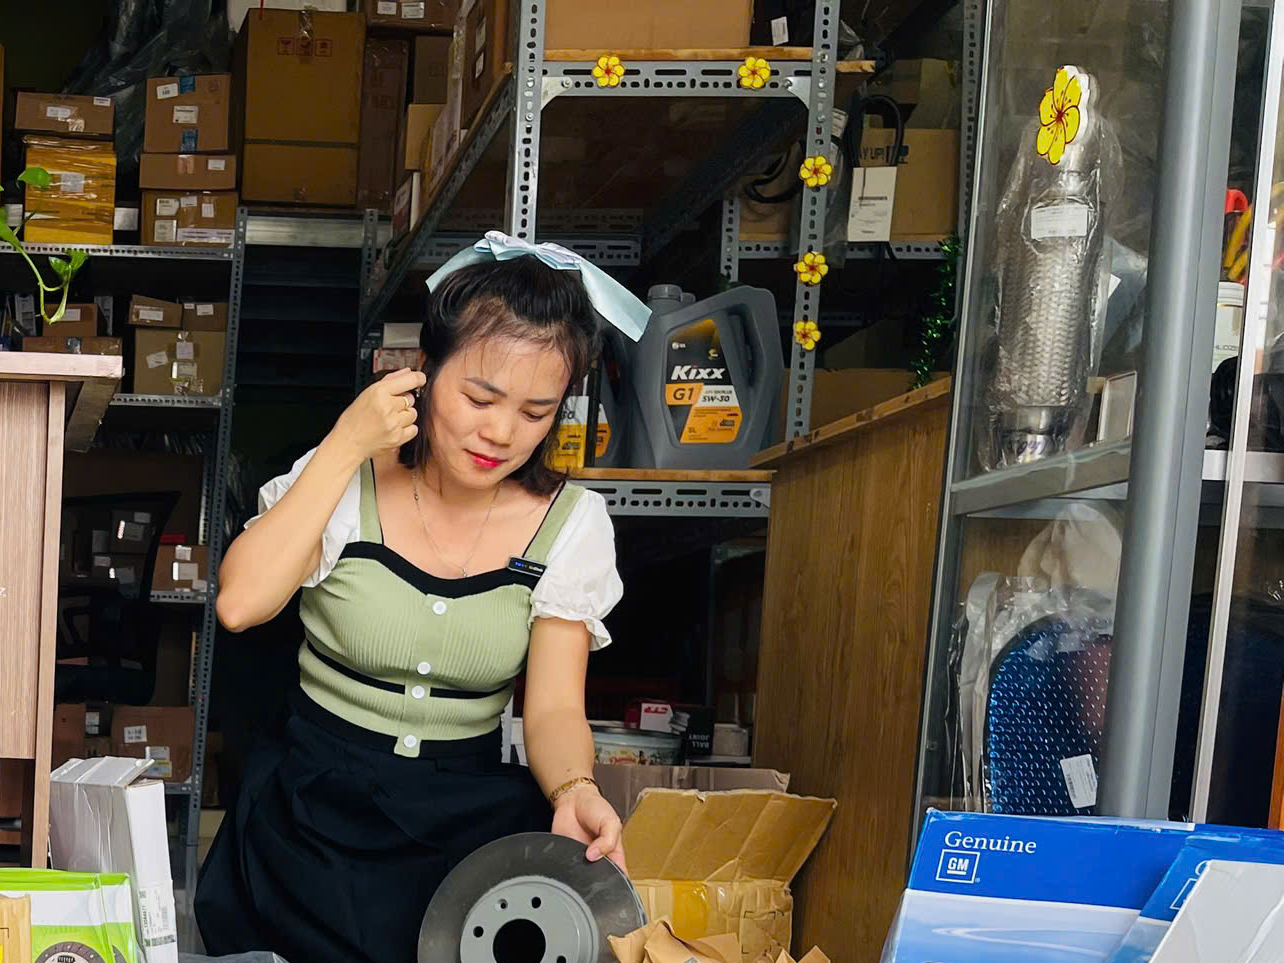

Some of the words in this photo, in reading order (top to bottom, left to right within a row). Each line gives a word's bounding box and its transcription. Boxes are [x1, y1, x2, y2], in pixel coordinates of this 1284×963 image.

[671, 365, 725, 380] Kixx
[673, 387, 694, 401] G1
[944, 830, 1037, 855] Genuine
[947, 857, 970, 872] GM
